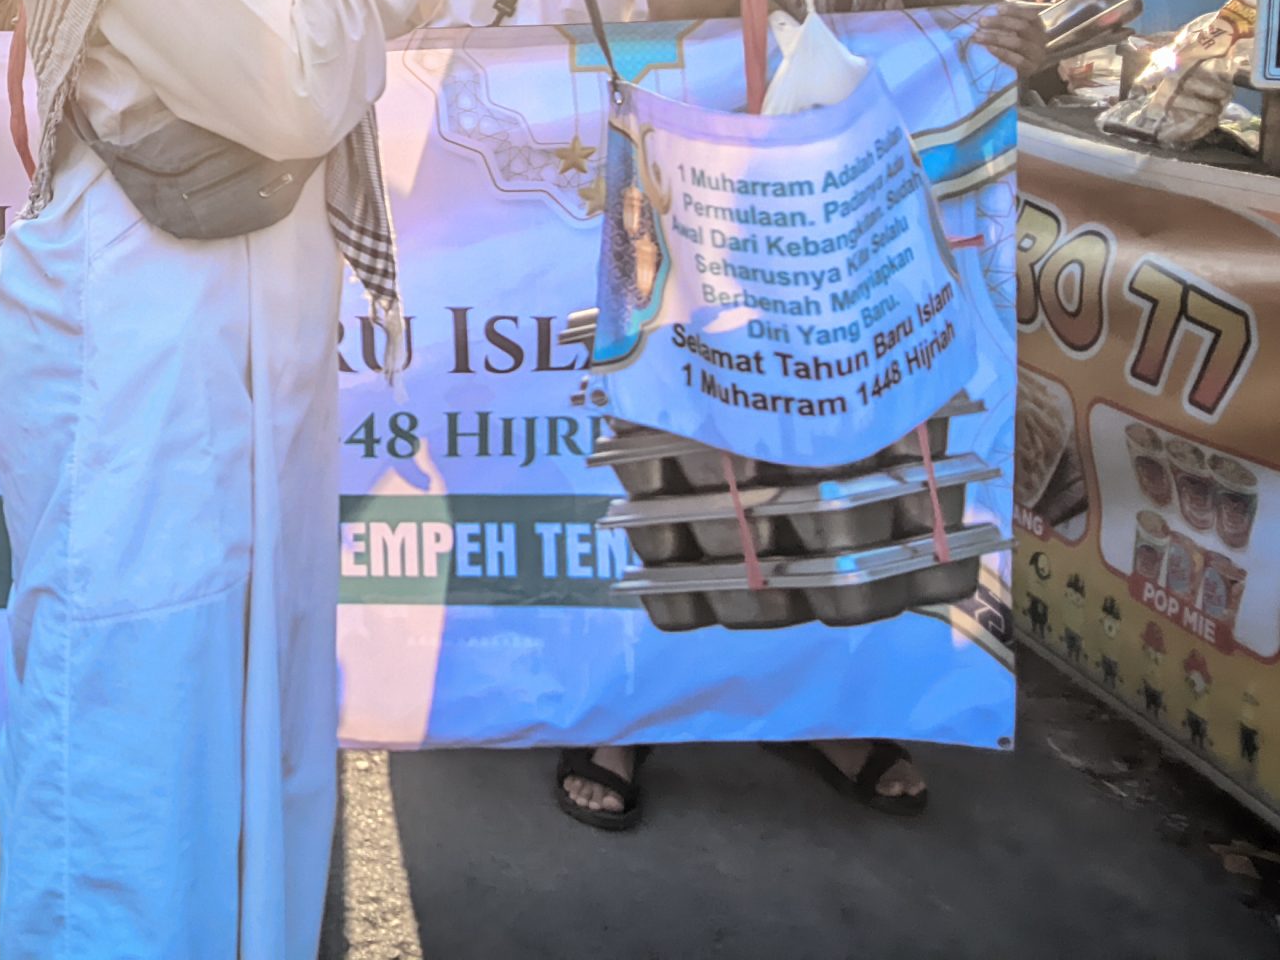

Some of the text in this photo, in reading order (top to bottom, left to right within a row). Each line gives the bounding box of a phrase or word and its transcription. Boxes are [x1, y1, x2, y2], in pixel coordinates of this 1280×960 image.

[678, 163, 686, 183] 1
[690, 166, 815, 198] Muharram
[821, 150, 875, 193] Adalah
[682, 192, 816, 227] Permulaan.
[710, 228, 759, 254] Dari
[694, 253, 842, 291] Seharusnya
[702, 283, 822, 316] Berbenah
[1015, 199, 1109, 353] RO
[445, 306, 591, 375] ISL
[672, 281, 954, 381] Selamat Tahun Baru Islam
[747, 318, 790, 343] Diri
[797, 319, 861, 346] Yang
[682, 363, 692, 387] 1
[701, 369, 848, 417] Muharram
[856, 359, 902, 406] 1448
[339, 410, 421, 459] 48
[444, 411, 601, 468] HIJRI
[339, 521, 518, 579] EMPEH
[535, 521, 644, 581] TEN
[1143, 581, 1216, 643] POP MIE
